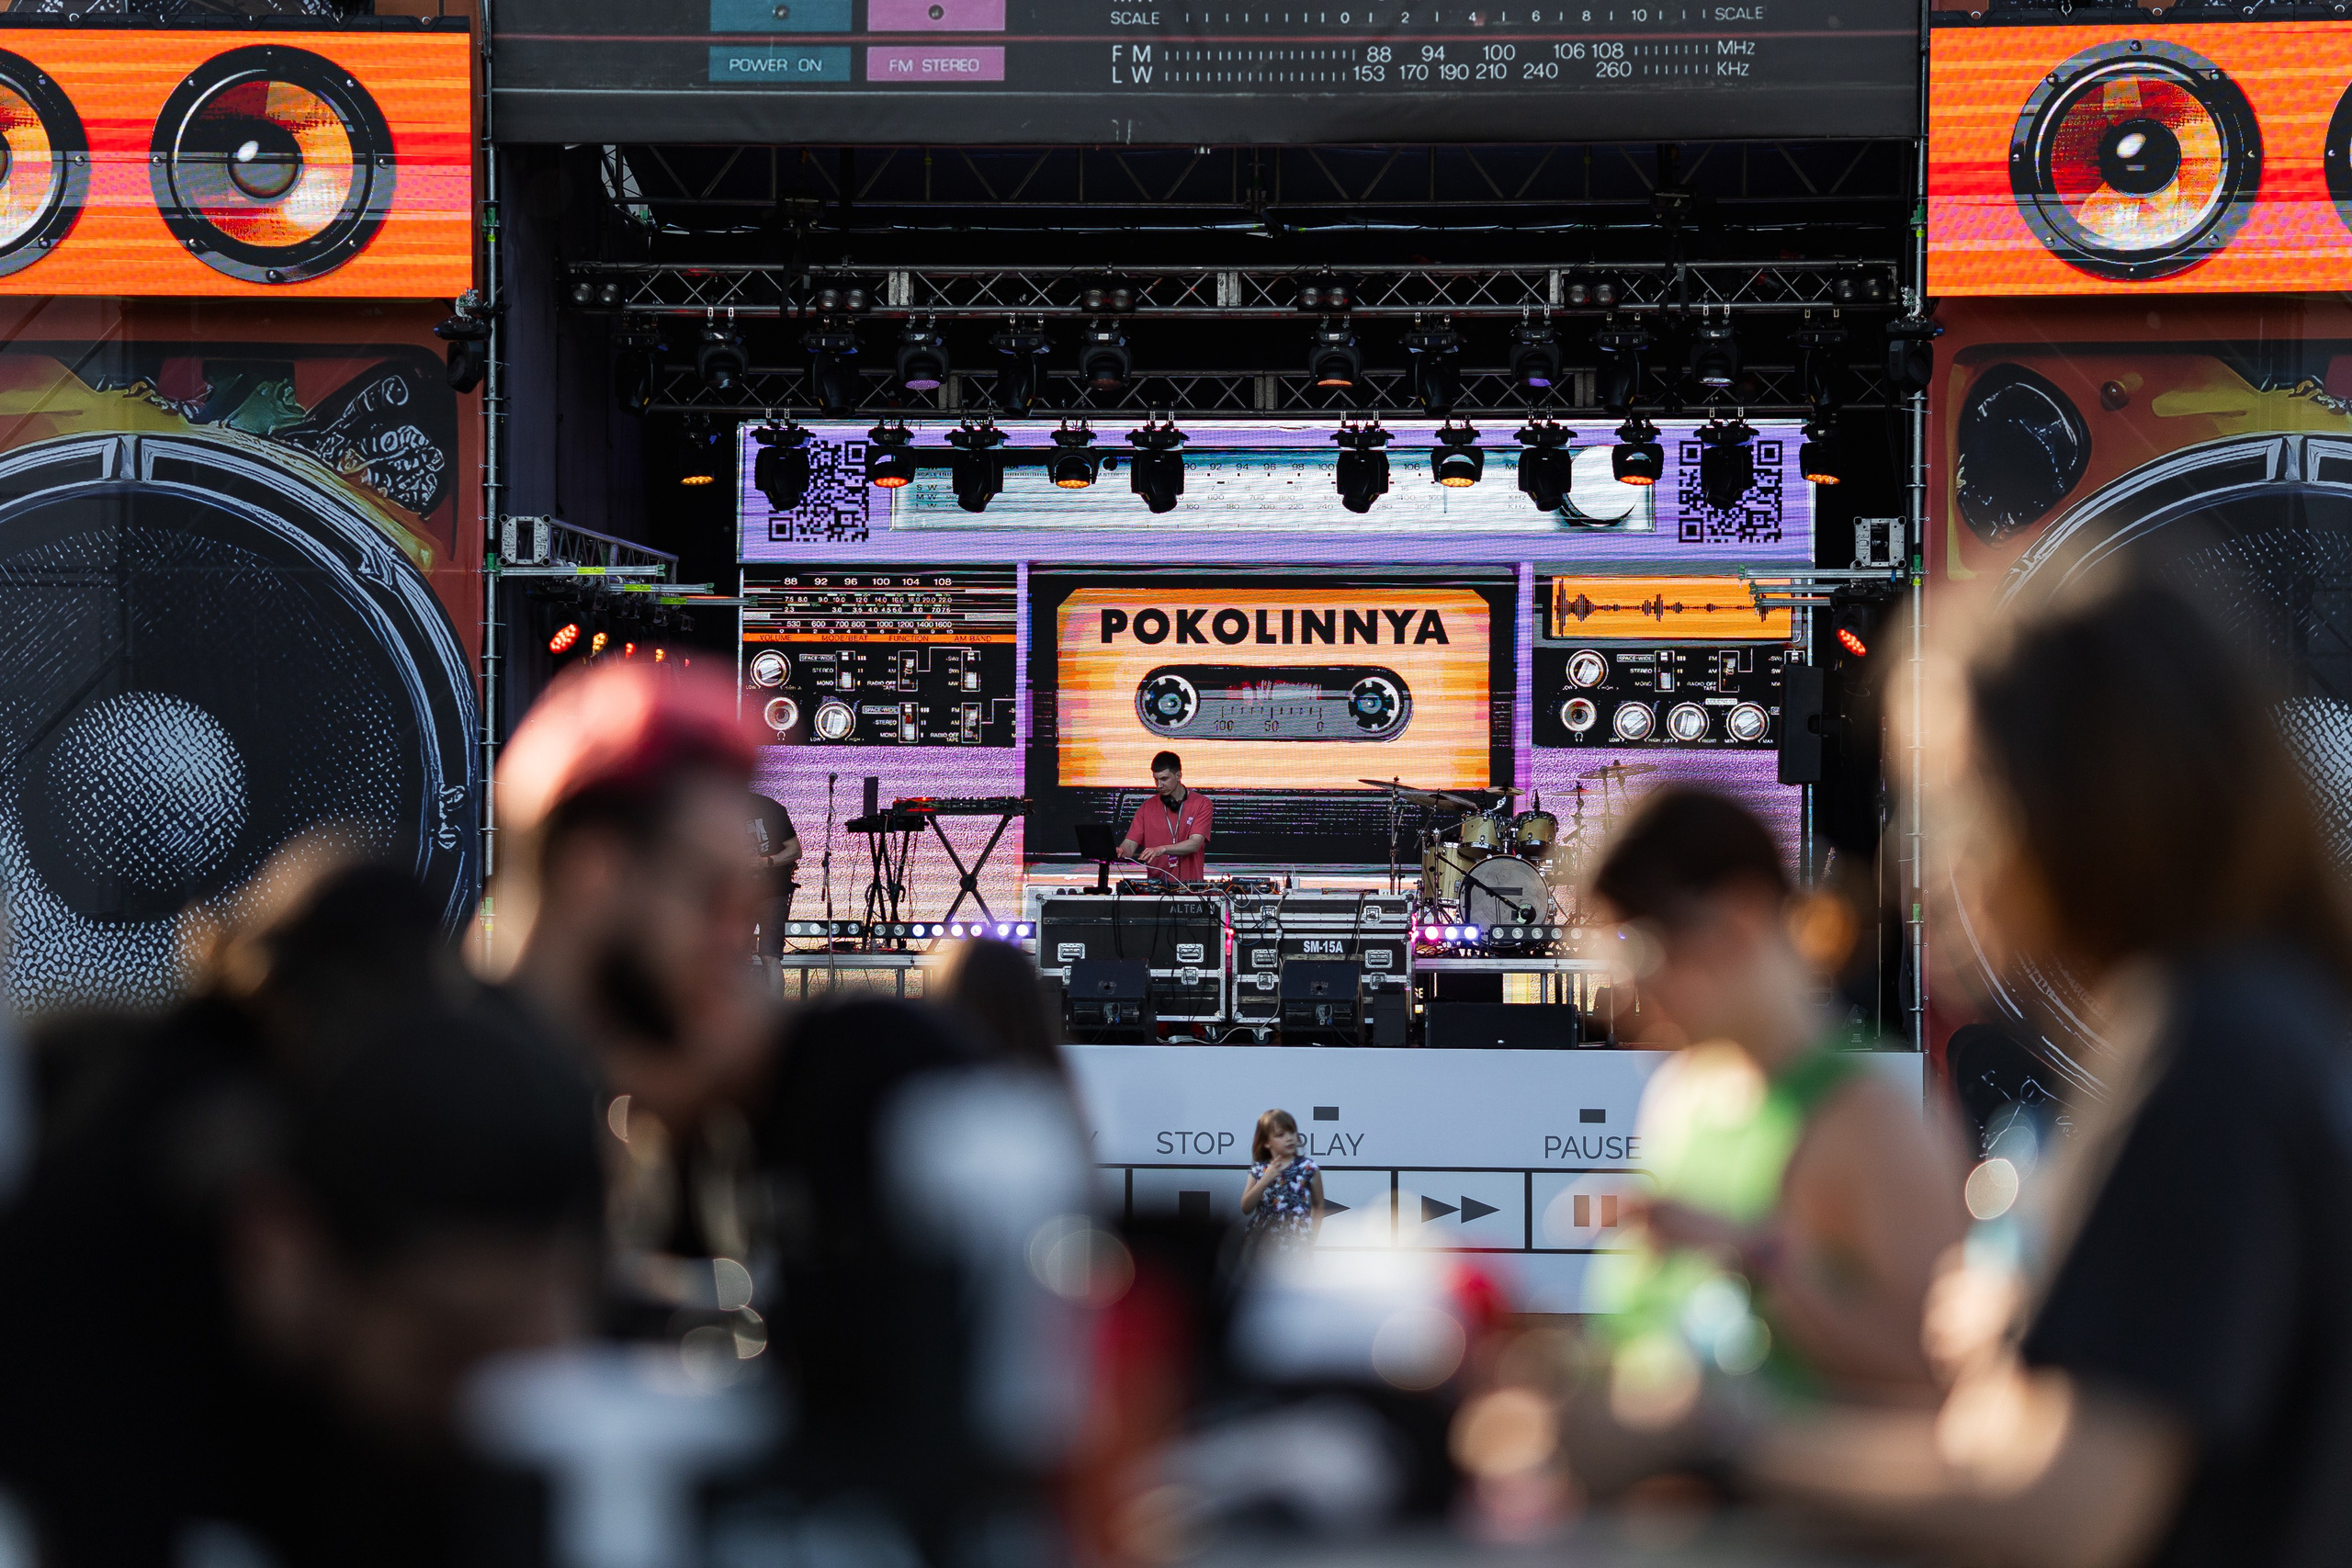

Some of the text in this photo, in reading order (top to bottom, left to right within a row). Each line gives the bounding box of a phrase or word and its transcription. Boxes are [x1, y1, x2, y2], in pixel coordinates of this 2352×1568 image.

[1110, 6, 1764, 25] SCALE 0 2 4 6 8 10 SCALE
[1366, 46, 1392, 62] 88
[1421, 45, 1445, 62] 94
[1483, 44, 1515, 61] 100
[1554, 42, 1585, 60] 106
[1591, 42, 1624, 59] 108
[1717, 40, 1756, 55] MHz
[729, 59, 822, 73] POWER ON
[888, 59, 979, 72] FM STEREO
[1352, 65, 1385, 82] 153
[1399, 64, 1429, 81] 170
[1439, 63, 1470, 80] 190
[1476, 63, 1507, 79] 210
[1523, 62, 1558, 79] 240
[1596, 61, 1632, 78] 260
[1717, 61, 1749, 76] KHz
[784, 577, 952, 586] 88 92 96 100 104 108
[1101, 608, 1450, 645] POKOLINNYA
[1214, 720, 1234, 731] 100
[1264, 720, 1280, 732] 50
[1170, 904, 1203, 914] ALTEA
[1303, 940, 1344, 953] SM-15A
[1156, 1131, 1235, 1156] STOP
[1544, 1135, 1643, 1160] PAUSE
